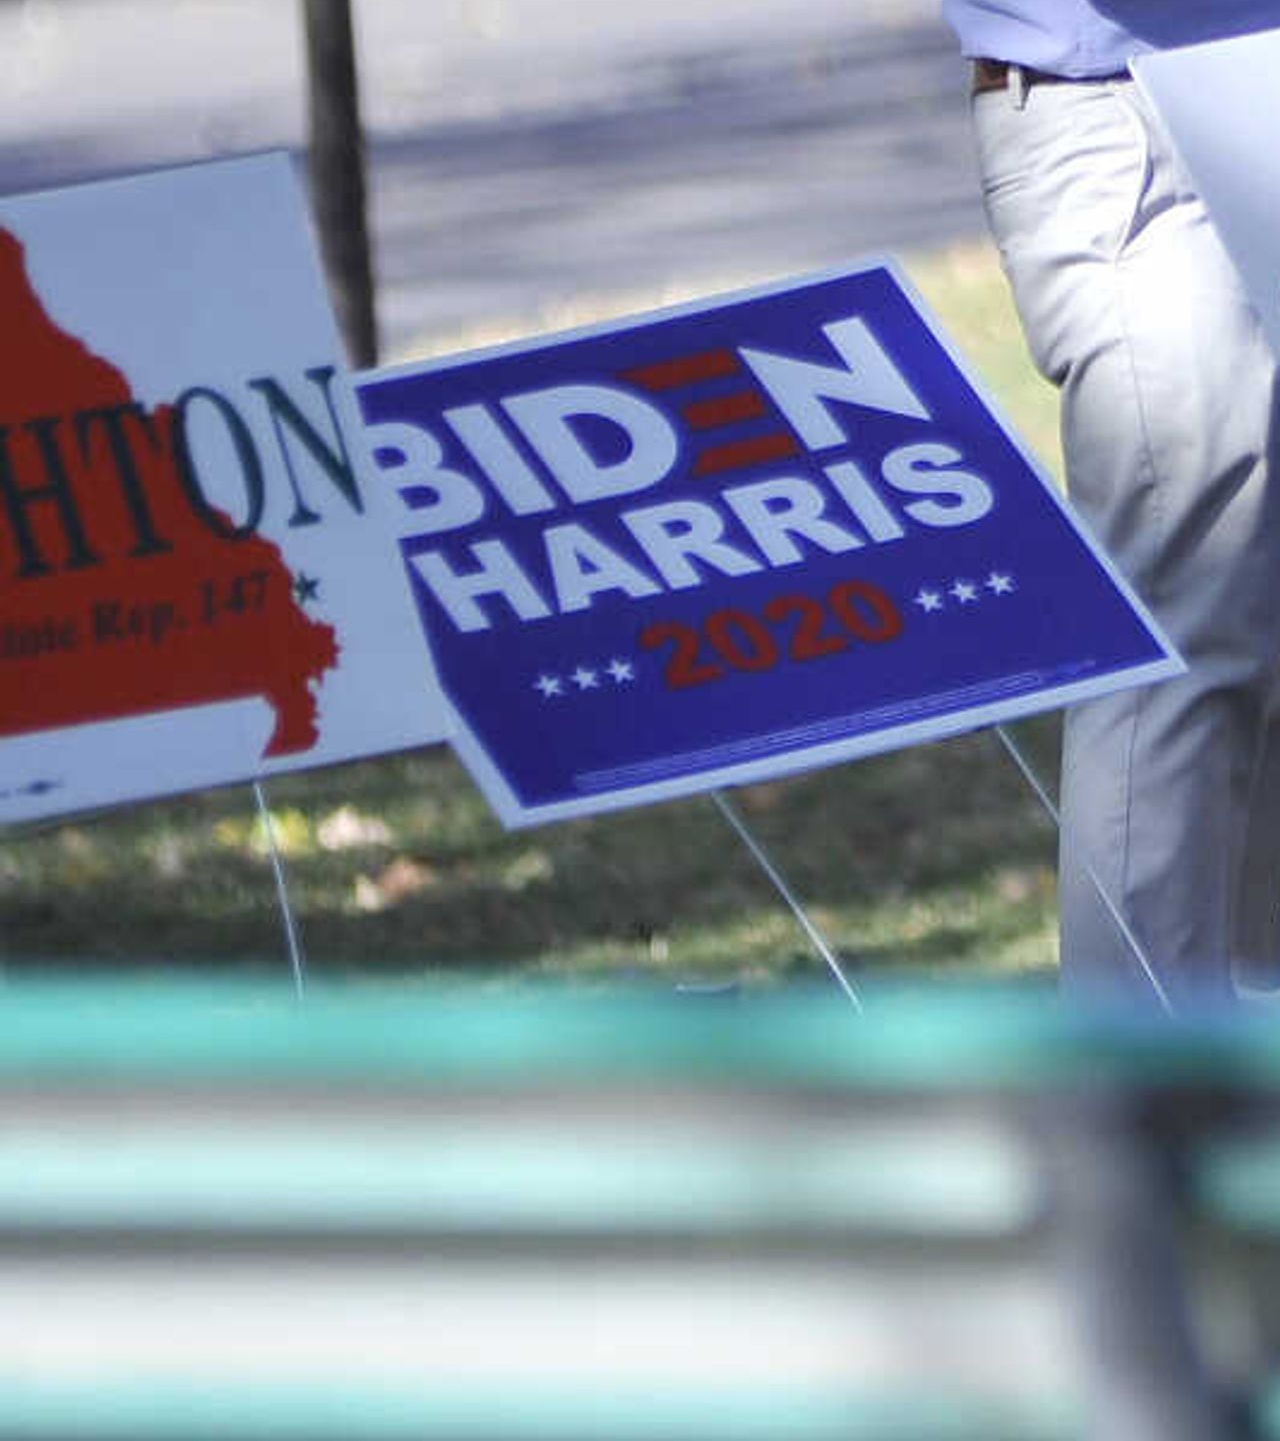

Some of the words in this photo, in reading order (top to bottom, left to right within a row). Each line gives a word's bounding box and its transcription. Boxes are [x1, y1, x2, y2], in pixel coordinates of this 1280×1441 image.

[362, 317, 932, 539] BIDEN
[93, 600, 190, 644] Rep.
[198, 569, 270, 625] 147
[409, 442, 994, 633] HARRIS
[640, 579, 903, 690] 2020
